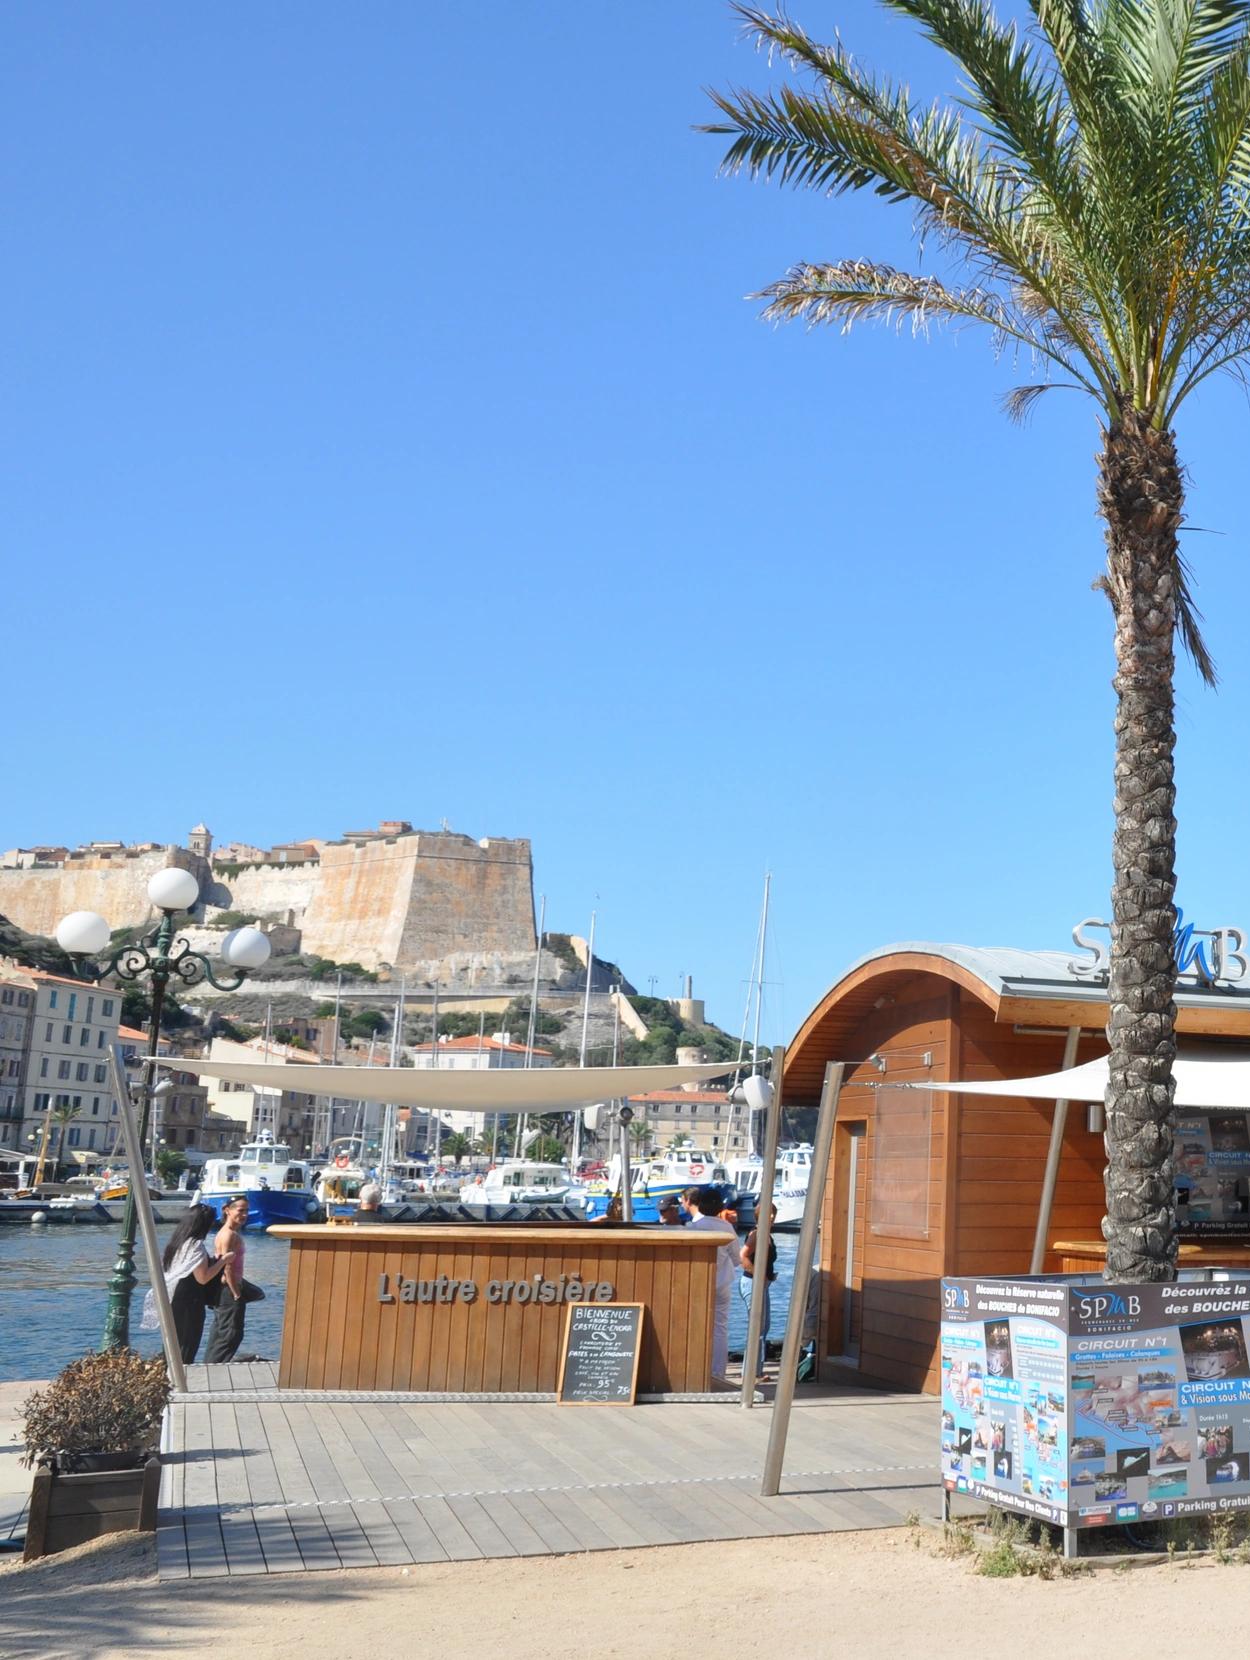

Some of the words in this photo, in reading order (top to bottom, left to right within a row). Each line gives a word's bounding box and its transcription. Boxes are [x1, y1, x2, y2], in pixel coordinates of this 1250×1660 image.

[1202, 1222, 1226, 1230] Parking
[378, 1273, 476, 1302] L'autre
[484, 1273, 614, 1303] croisière
[1161, 1286, 1231, 1298] Découvrez
[1234, 1284, 1247, 1295] la
[1026, 1304, 1060, 1317] BONIFACIO
[1078, 1293, 1142, 1319] SPMB
[1164, 1303, 1189, 1314] des
[576, 1308, 632, 1320] BIENVENUE
[1087, 1325, 1132, 1333] BONIFACIO
[1078, 1338, 1138, 1351] CIRCUIT
[1145, 1336, 1167, 1347] N°1
[1181, 1381, 1235, 1393] CIRCUIT
[1181, 1395, 1188, 1405] &
[1189, 1392, 1216, 1404] Vision
[1218, 1394, 1238, 1402] sous
[981, 1487, 998, 1502] Parking
[998, 1491, 1014, 1505] Gratuit
[1014, 1496, 1025, 1509] Pour
[1025, 1500, 1034, 1511] Nos
[1035, 1503, 1052, 1517] Clients
[1165, 1504, 1173, 1515] P
[1177, 1501, 1217, 1513] Parking
